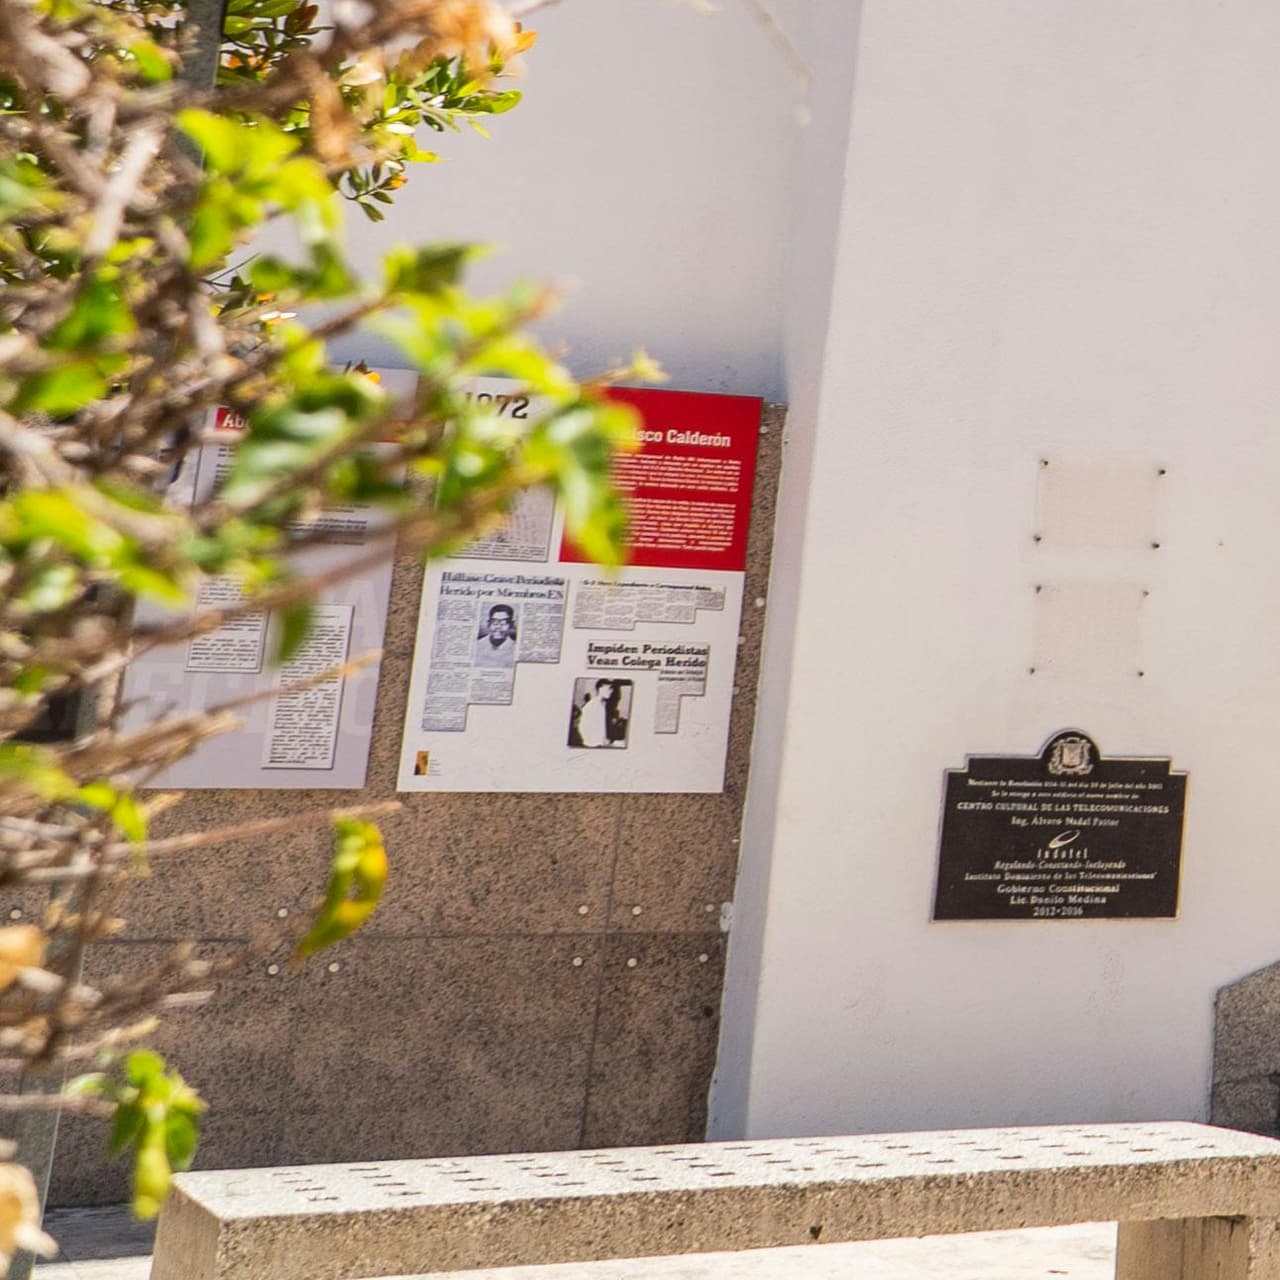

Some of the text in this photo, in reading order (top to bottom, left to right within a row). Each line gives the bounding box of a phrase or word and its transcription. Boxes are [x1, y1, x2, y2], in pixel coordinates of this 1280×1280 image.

[666, 429, 731, 447] Calderón
[440, 585, 475, 596] Herido
[588, 642, 709, 656] Impiden Periodistas
[588, 655, 707, 670] Vean Colega Herido
[957, 801, 1170, 814] CENTRO CULTURAL DE LAS TELECOMUNICACIONES
[996, 883, 1120, 894] Gobierno Constitucional
[1030, 895, 1065, 905] Danilo
[1067, 895, 1107, 904] Medina
